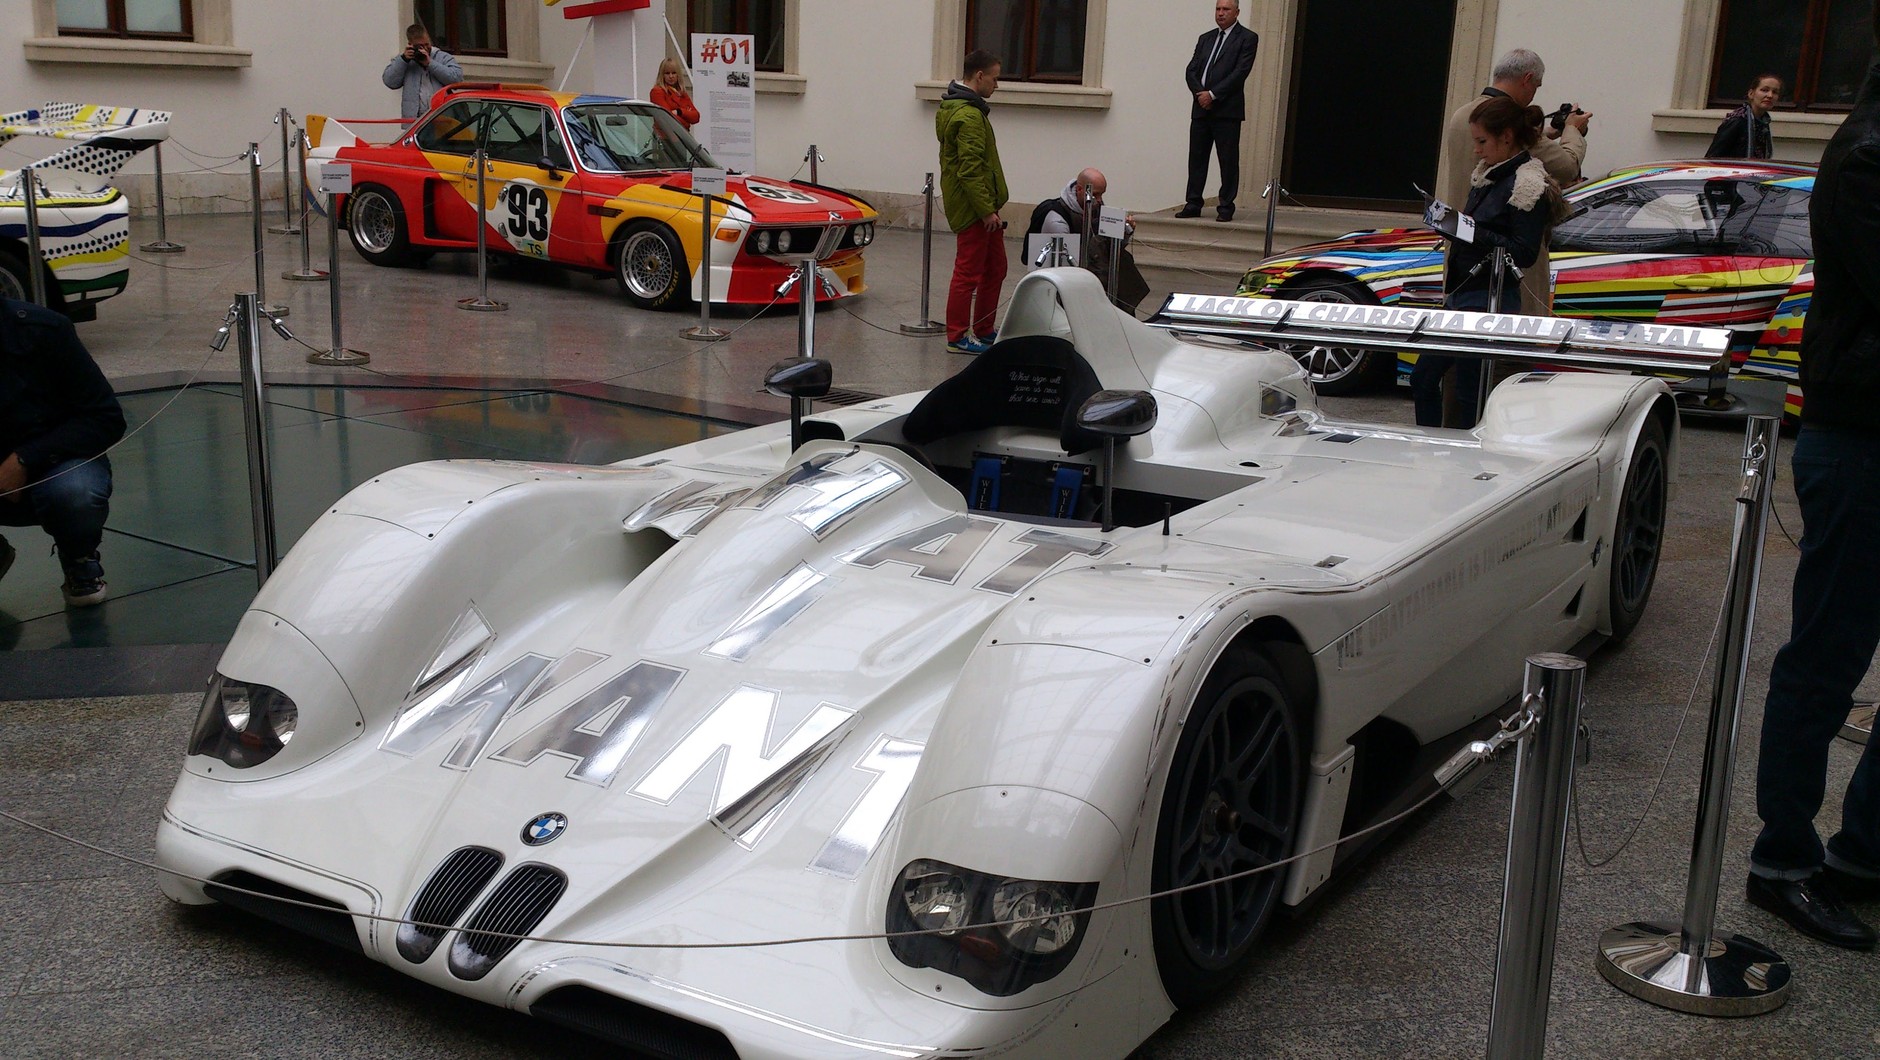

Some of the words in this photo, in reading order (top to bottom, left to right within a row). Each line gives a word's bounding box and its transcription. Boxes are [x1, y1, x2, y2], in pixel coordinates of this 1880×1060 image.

[700, 37, 750, 65] #01
[508, 184, 548, 241] 93
[748, 186, 815, 202] 93
[1184, 296, 1258, 318] LACK
[1308, 304, 1465, 331] CHARISMA
[1475, 315, 1538, 336] CAN
[1549, 320, 1593, 340] BE
[1604, 324, 1705, 348] FATAL
[979, 479, 991, 510] WILL
[377, 599, 926, 882] WANT
